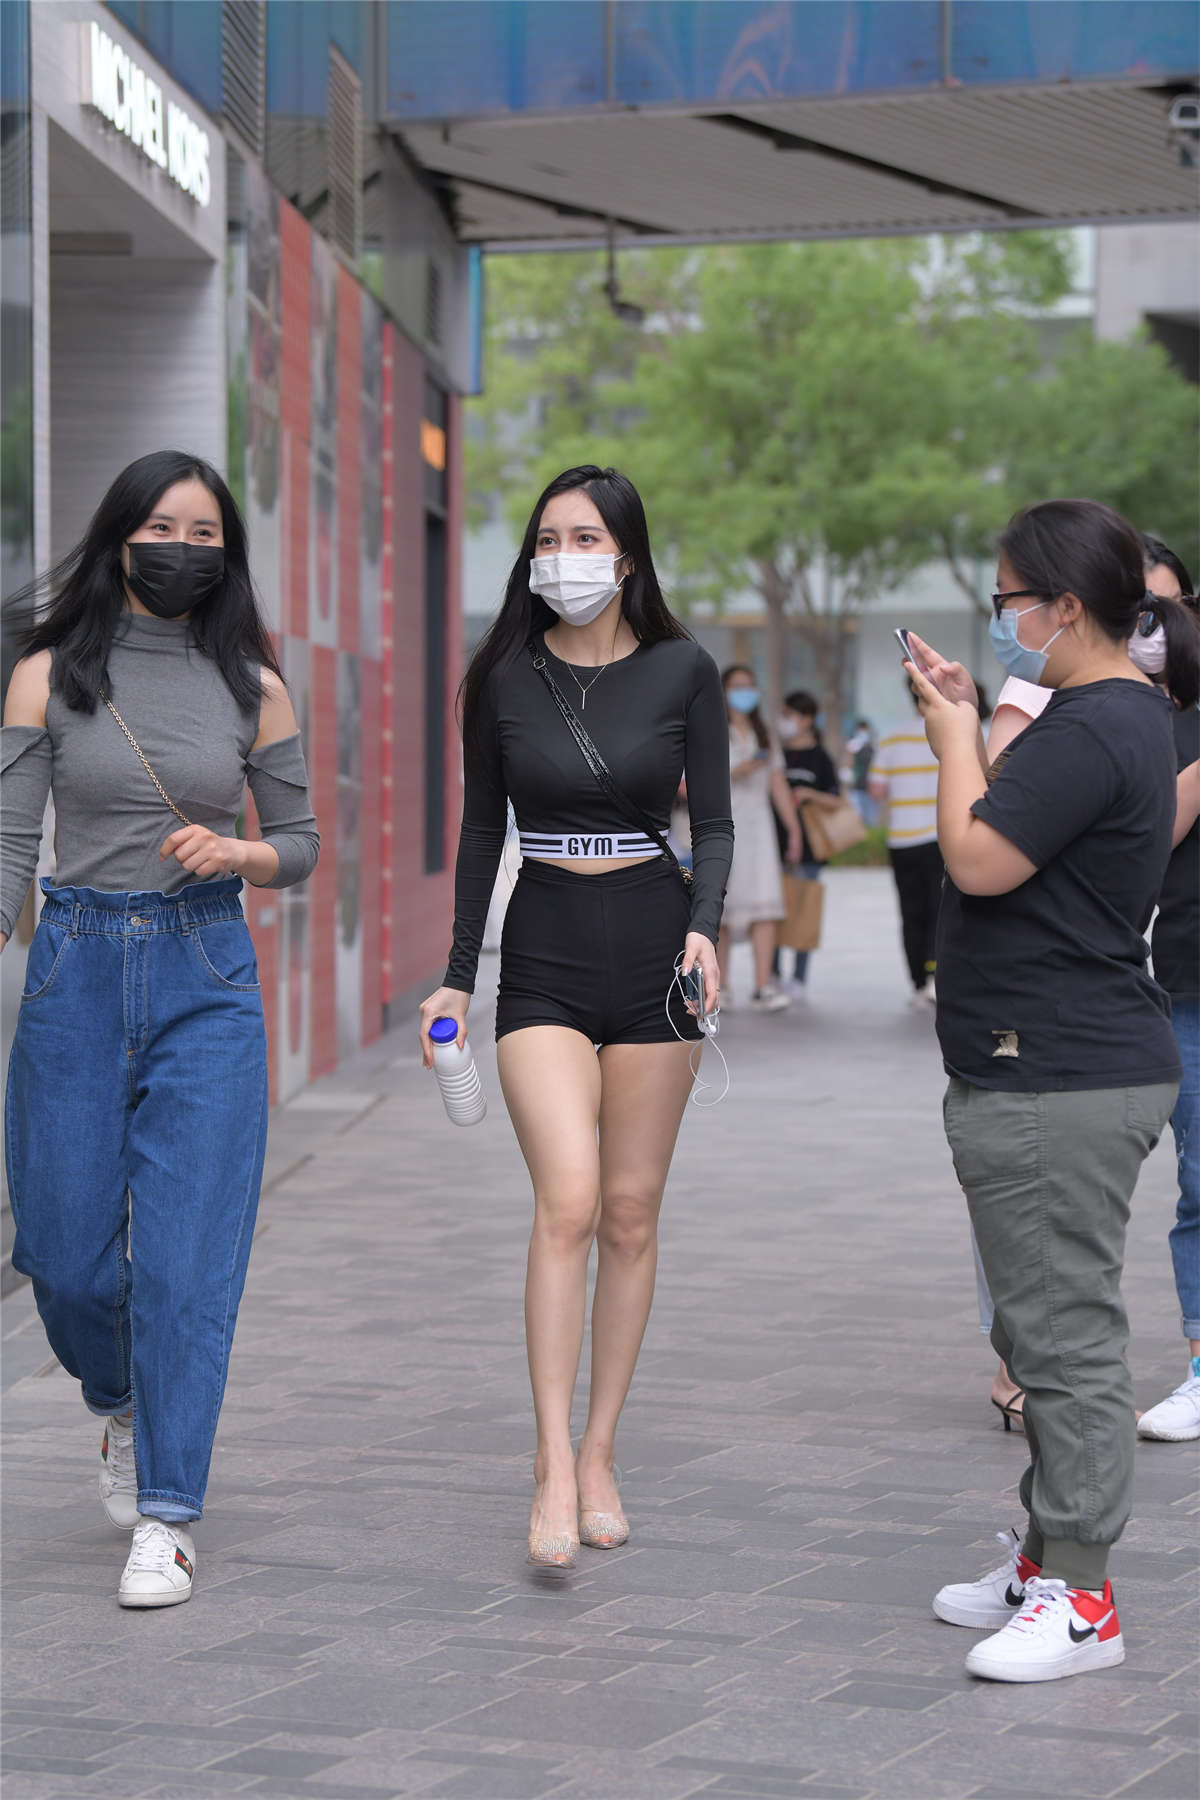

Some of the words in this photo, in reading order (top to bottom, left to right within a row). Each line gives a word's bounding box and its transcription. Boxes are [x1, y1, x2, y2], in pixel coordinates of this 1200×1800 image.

[90, 21, 167, 169] MICHAEL
[168, 101, 211, 207] KORS
[567, 837, 613, 856] GYM
